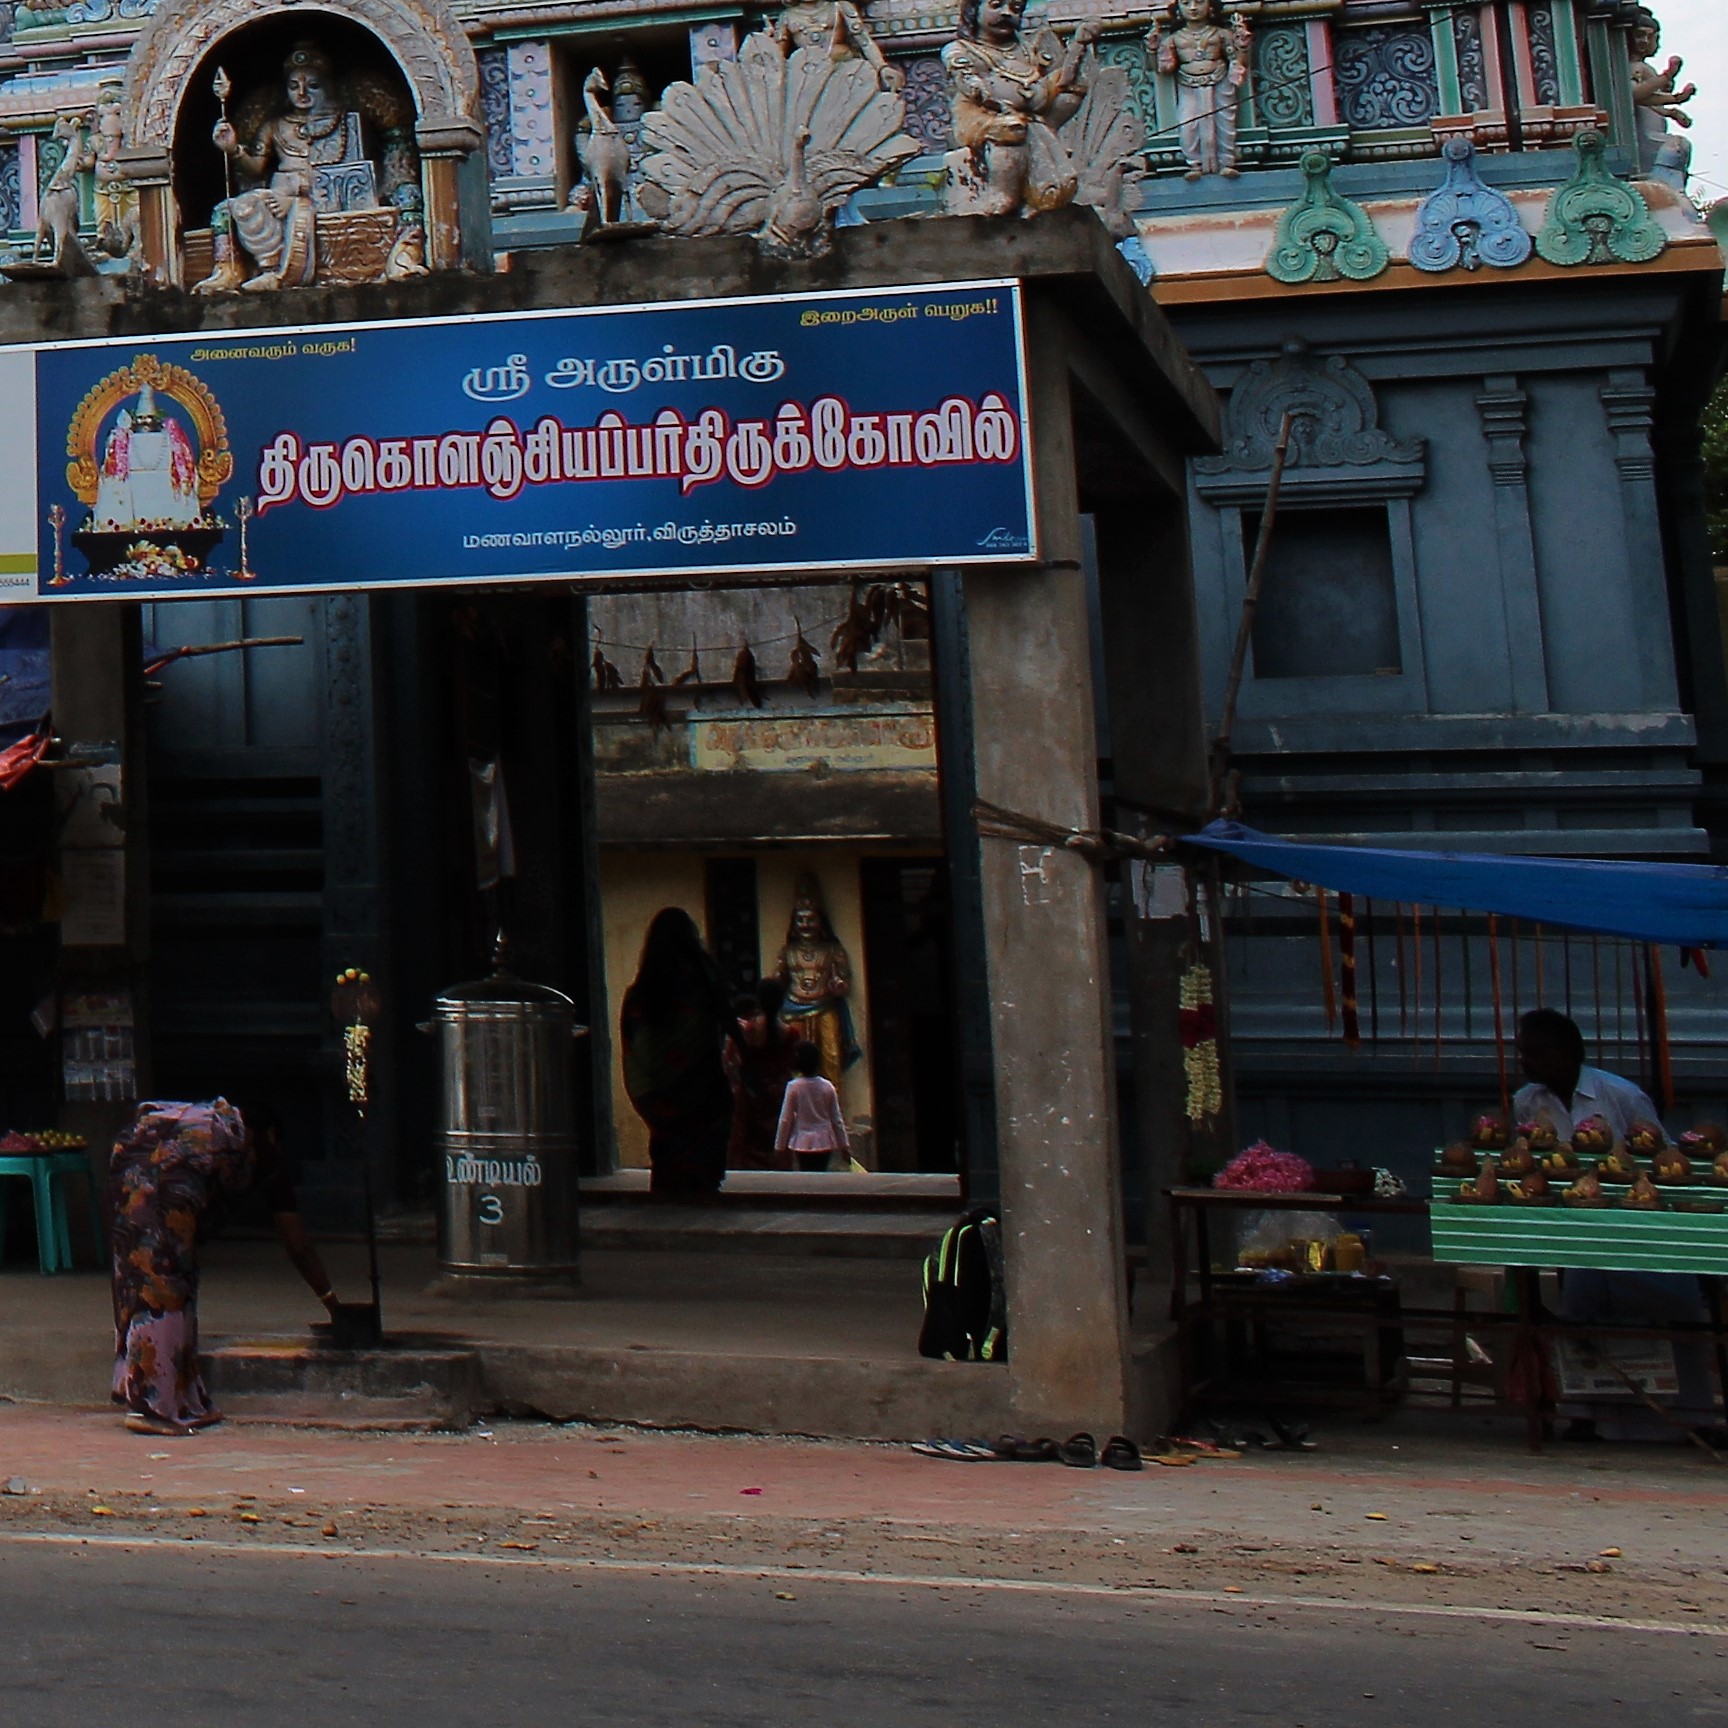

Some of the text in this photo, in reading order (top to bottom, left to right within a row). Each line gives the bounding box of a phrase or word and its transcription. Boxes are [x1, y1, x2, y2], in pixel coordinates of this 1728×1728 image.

[924, 298, 998, 321] பெறுக!!
[190, 337, 356, 361] அனைவரும் வருக!
[544, 344, 786, 393] அருள்மிகு
[446, 1150, 542, 1188] உண்டியல்
[479, 1195, 504, 1225] 3
